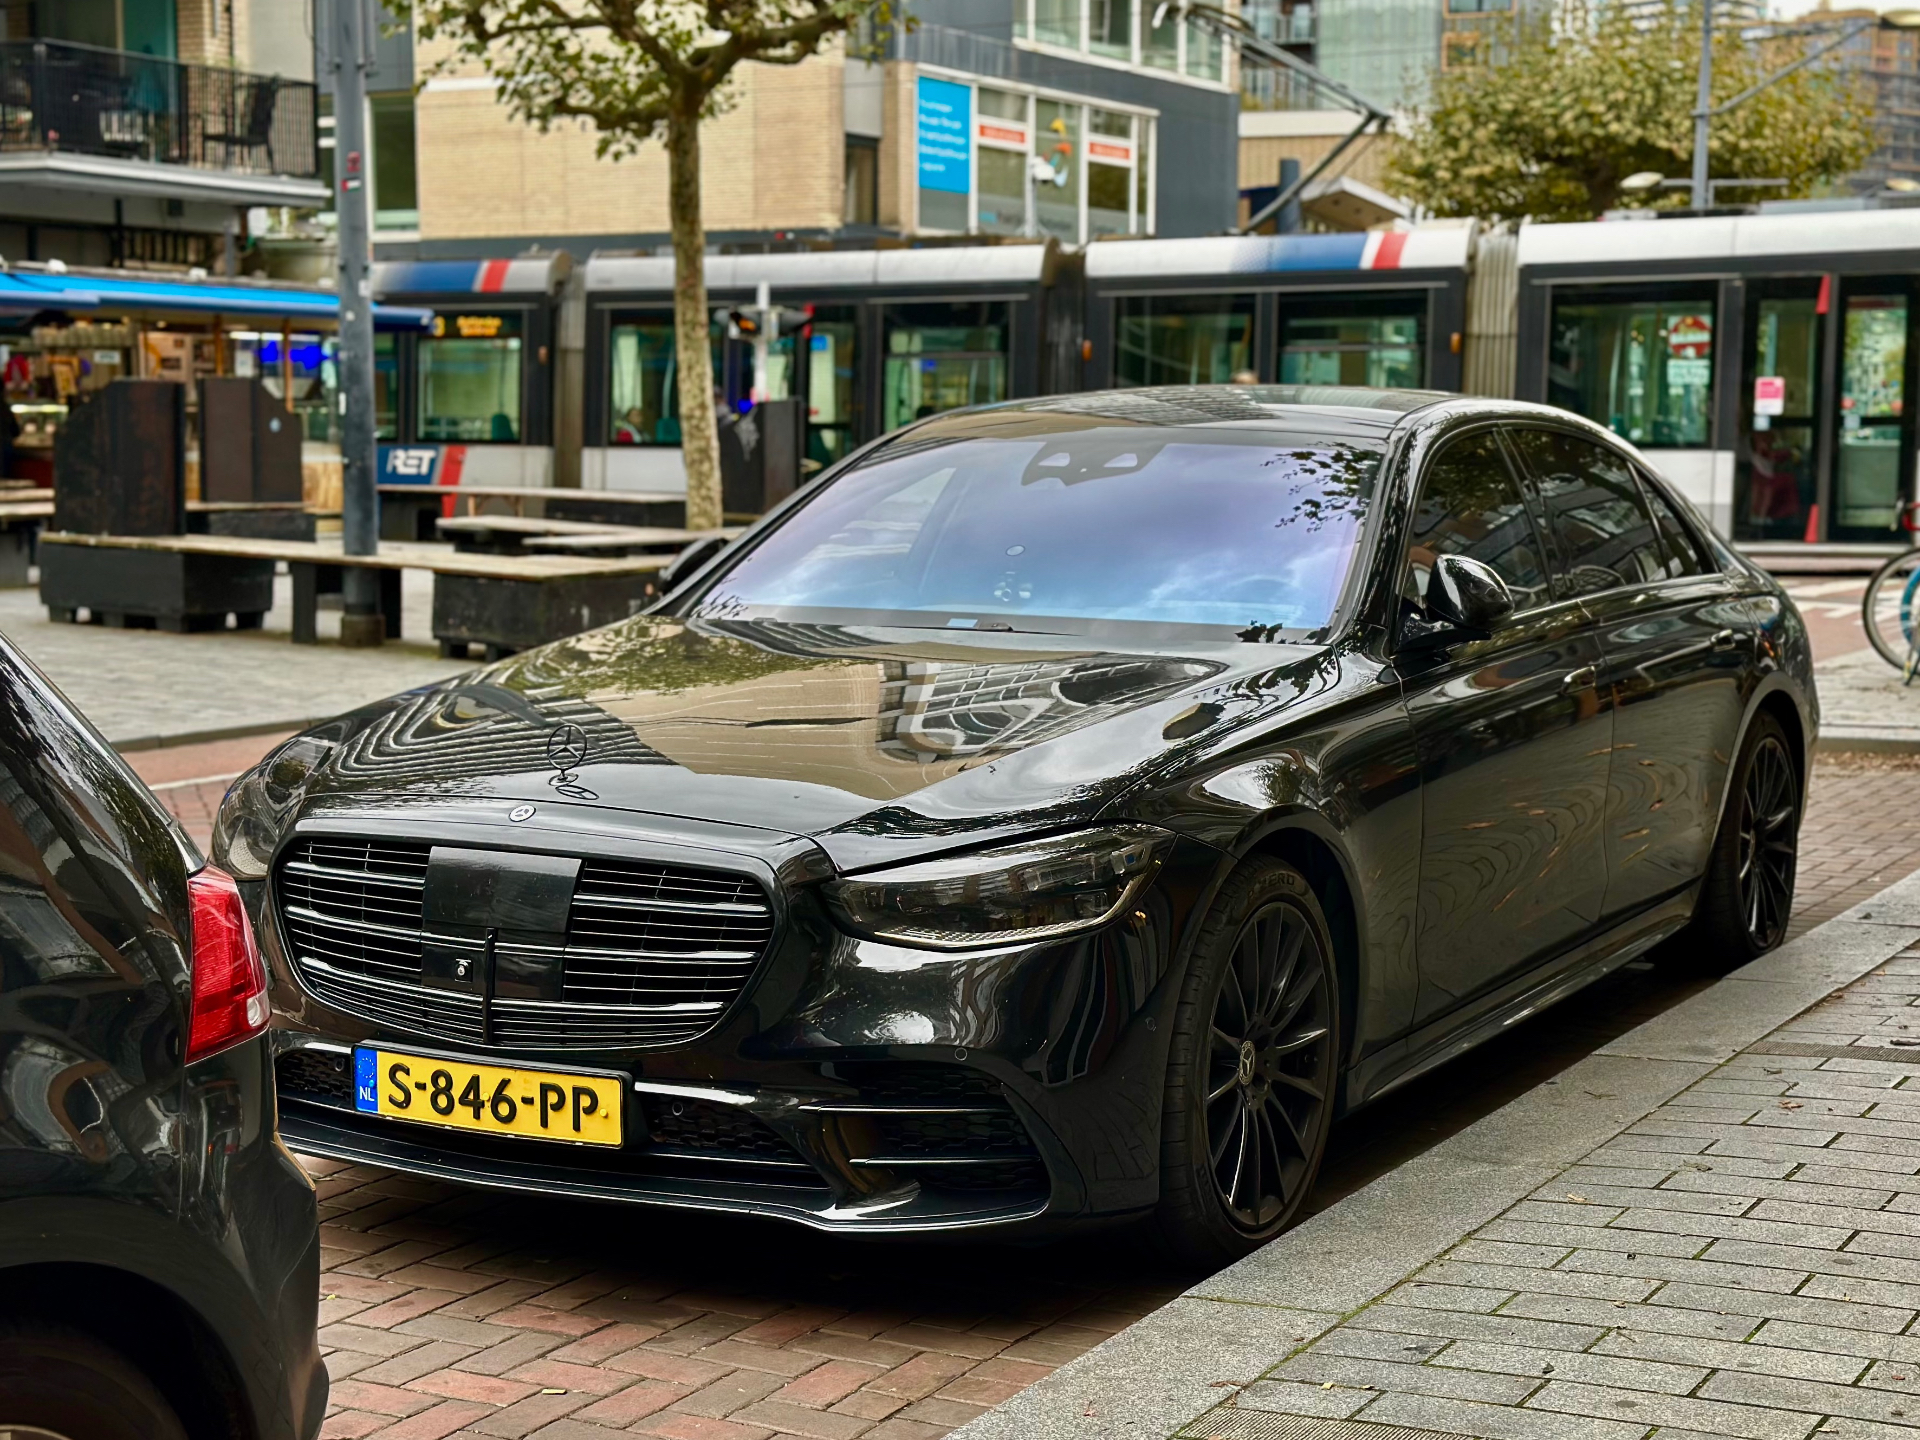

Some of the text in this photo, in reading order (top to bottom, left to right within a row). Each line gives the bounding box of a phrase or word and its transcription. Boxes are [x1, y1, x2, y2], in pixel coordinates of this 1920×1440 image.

[386, 449, 436, 474] RET
[359, 1086, 375, 1102] NL
[388, 1062, 599, 1132] S-846-PP
